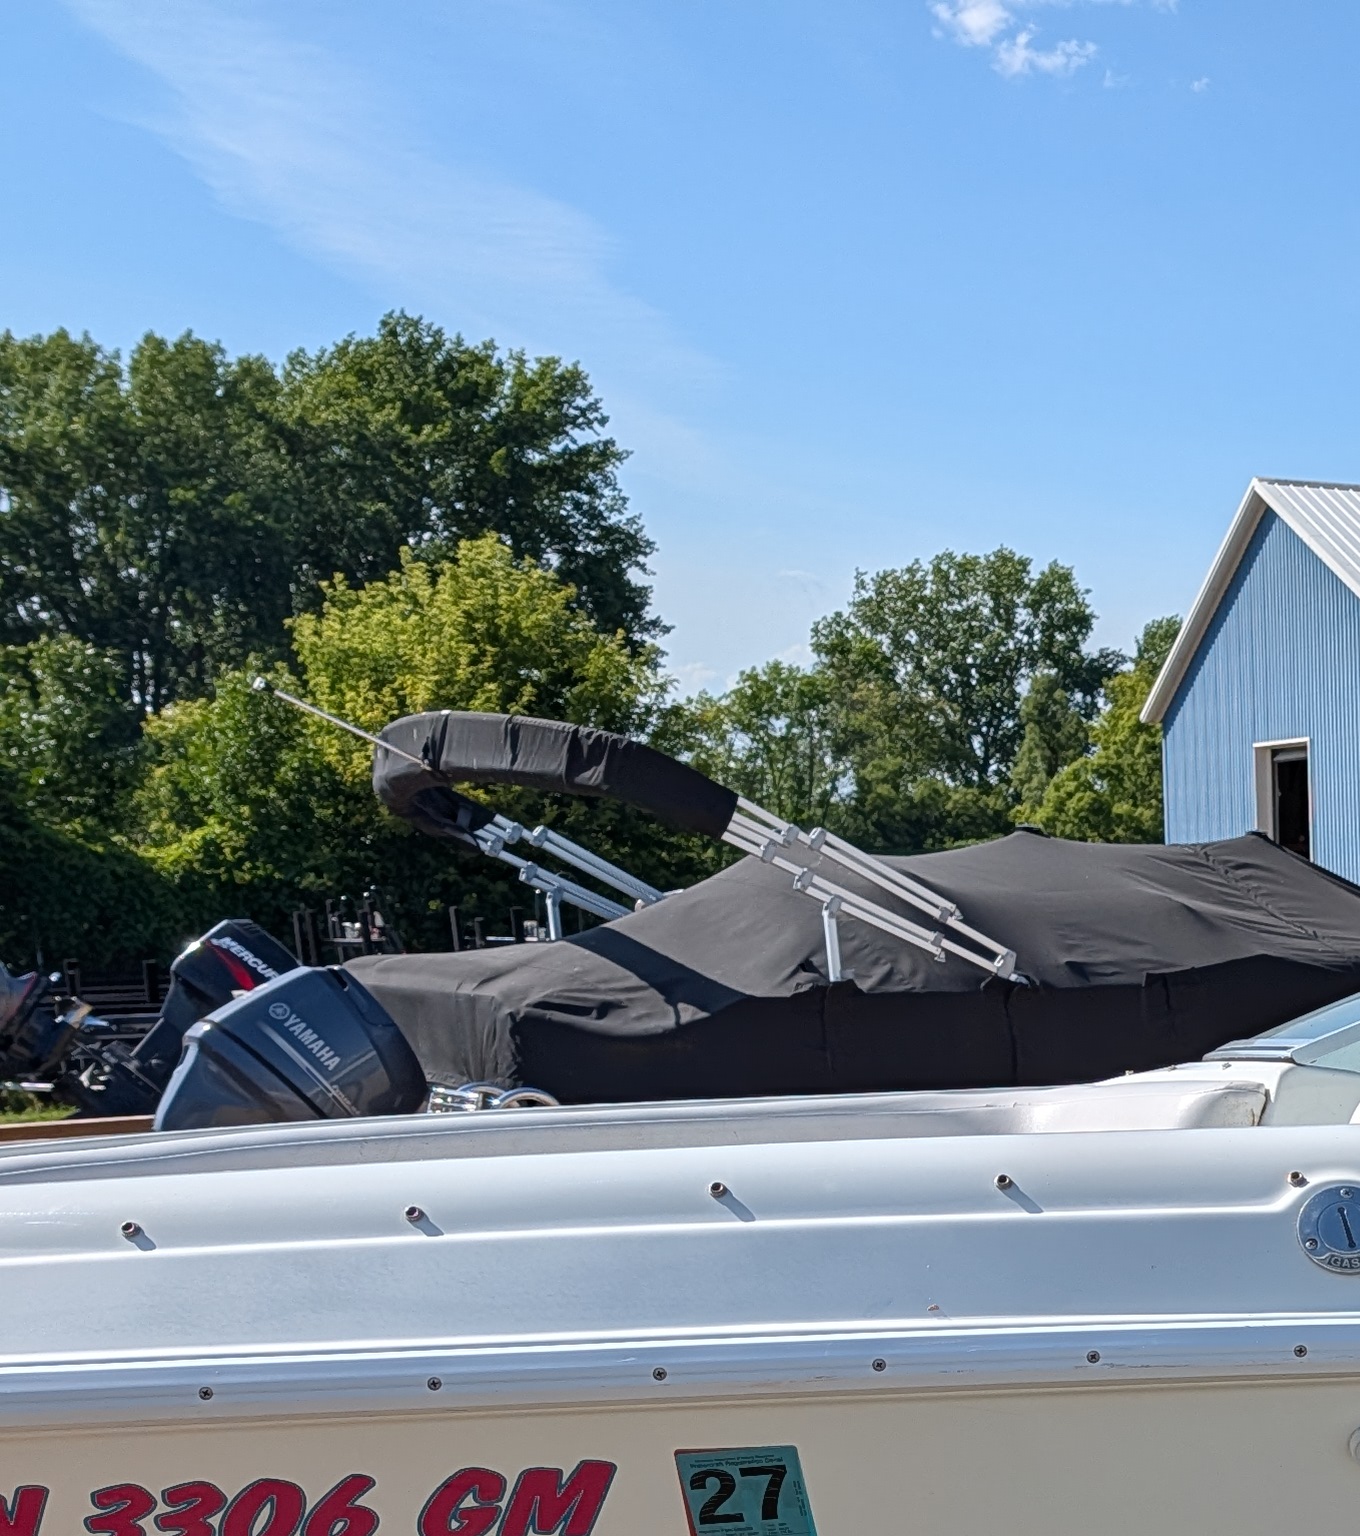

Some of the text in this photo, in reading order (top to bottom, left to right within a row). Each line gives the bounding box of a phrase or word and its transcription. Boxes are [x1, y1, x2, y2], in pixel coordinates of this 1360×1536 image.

[284, 1014, 341, 1071] YAMAHA
[1330, 1256, 1360, 1268] GAS
[690, 1464, 788, 1525] 27
